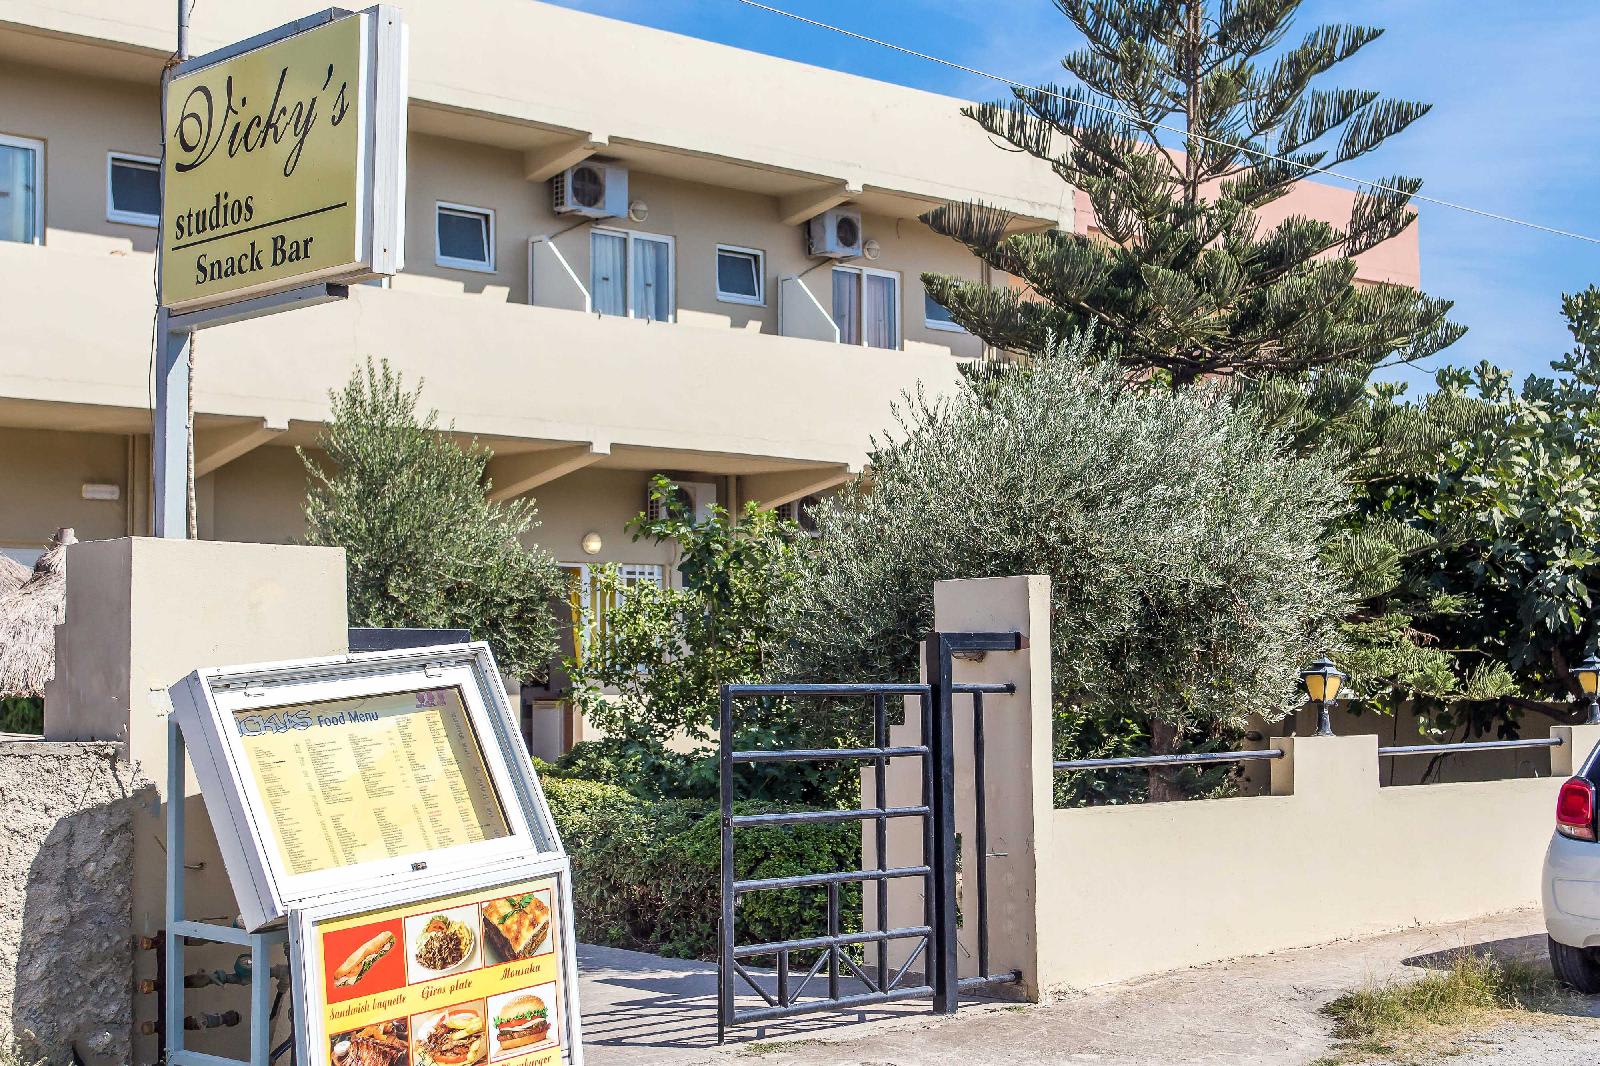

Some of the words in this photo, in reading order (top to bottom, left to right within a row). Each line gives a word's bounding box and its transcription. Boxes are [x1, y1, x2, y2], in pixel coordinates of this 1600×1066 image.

[174, 63, 350, 178] Vicky's
[175, 191, 254, 240] studios
[195, 242, 264, 285] Snack
[271, 234, 314, 267] Bar
[317, 712, 346, 728] Food
[348, 709, 379, 724] Menu
[421, 985, 446, 1000] Giros
[449, 979, 473, 994] plate
[329, 1000, 370, 1020] Sandwich
